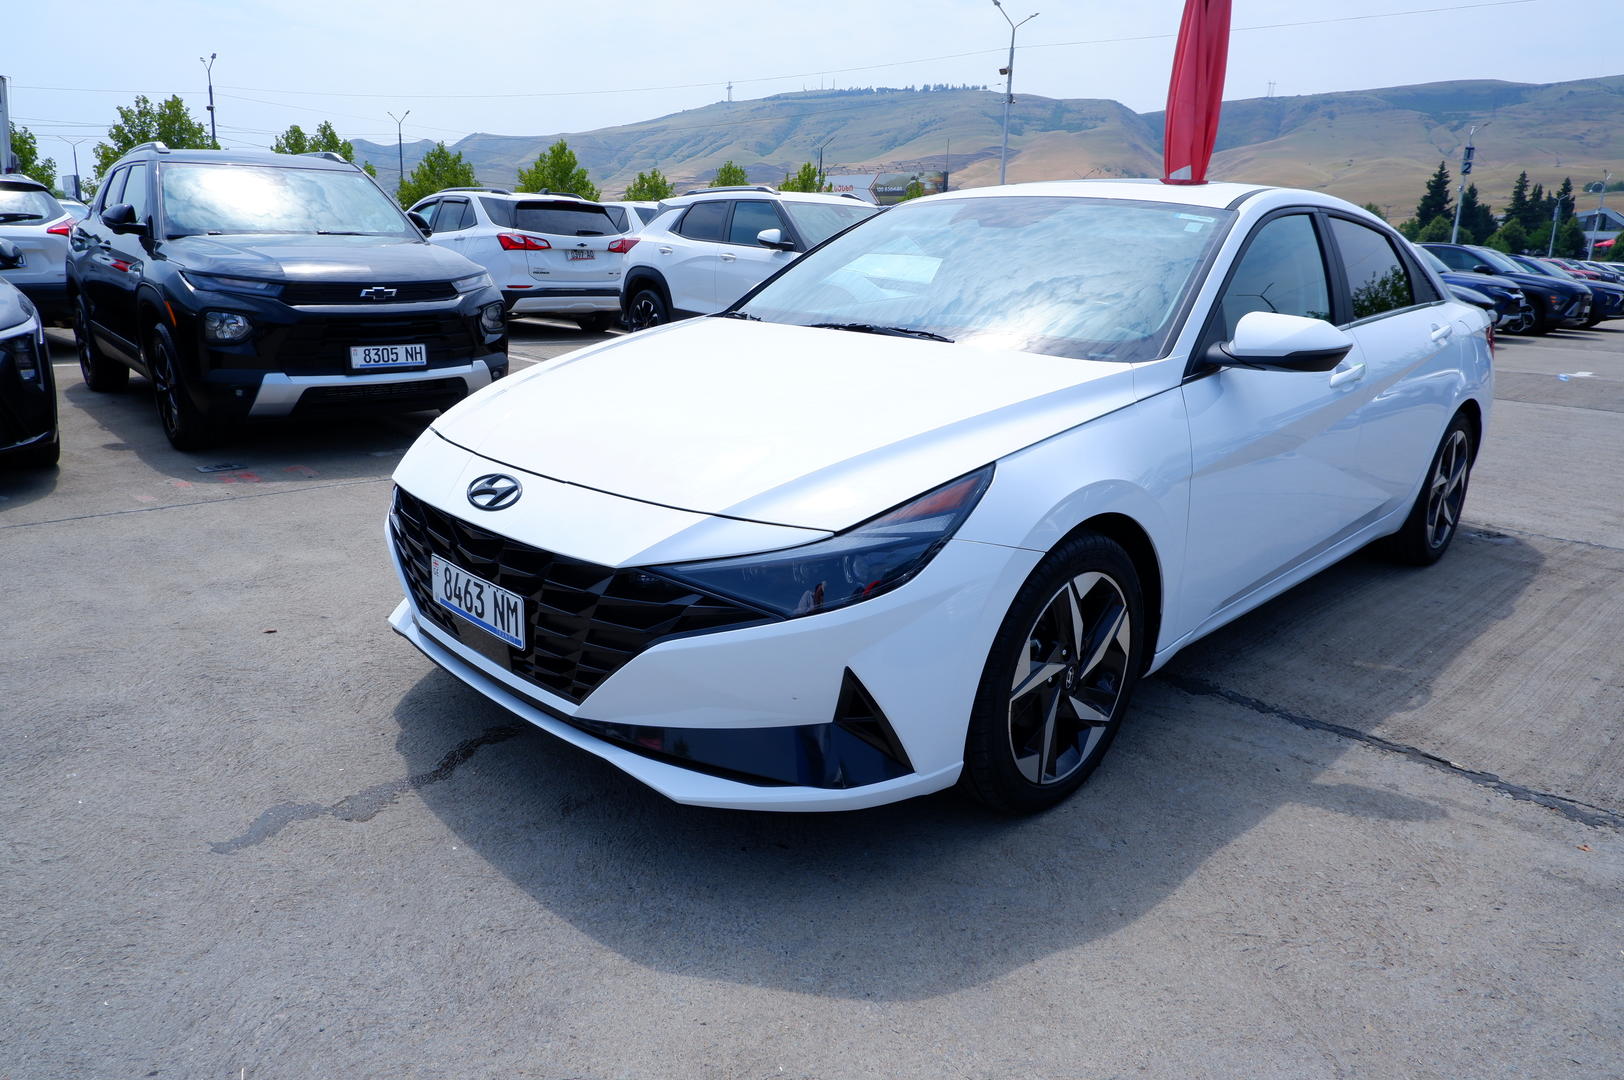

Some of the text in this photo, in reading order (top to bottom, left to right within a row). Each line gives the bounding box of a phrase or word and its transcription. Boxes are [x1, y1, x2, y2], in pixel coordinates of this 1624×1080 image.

[363, 346, 423, 363] 8305 NH
[444, 566, 519, 638] 8463 NM
